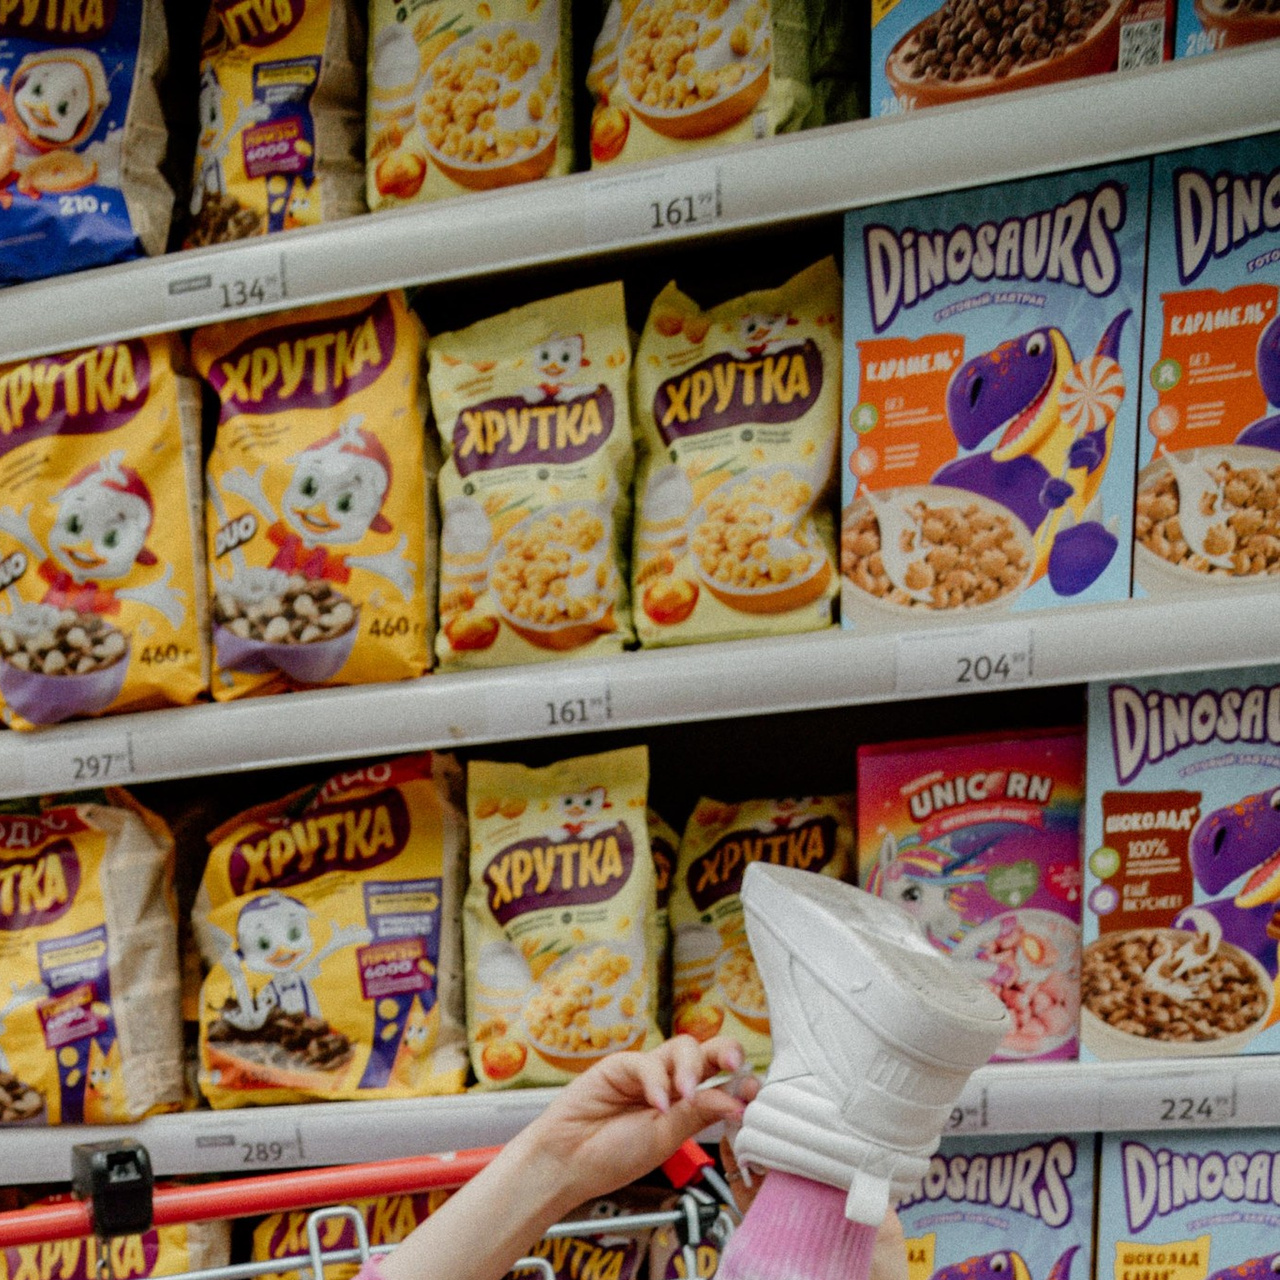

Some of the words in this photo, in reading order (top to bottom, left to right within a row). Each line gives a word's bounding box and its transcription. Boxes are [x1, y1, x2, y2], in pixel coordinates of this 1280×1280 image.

[58, 195, 98, 217] 210
[867, 186, 1122, 328] DINOSAURS
[221, 282, 266, 309] 134
[219, 318, 384, 402] ХРУТКА
[661, 354, 812, 428] ХРУТКА
[458, 399, 604, 461] ХРУТКА
[368, 615, 410, 639] 460
[139, 644, 179, 667] 460
[956, 656, 1011, 684] 204
[73, 756, 113, 780] 297
[910, 772, 1052, 819] UNICRN
[243, 804, 395, 893] ХРУТКА
[489, 835, 625, 910] ХРУТКА
[1160, 1099, 1213, 1121] 224
[242, 1140, 283, 1163] 289
